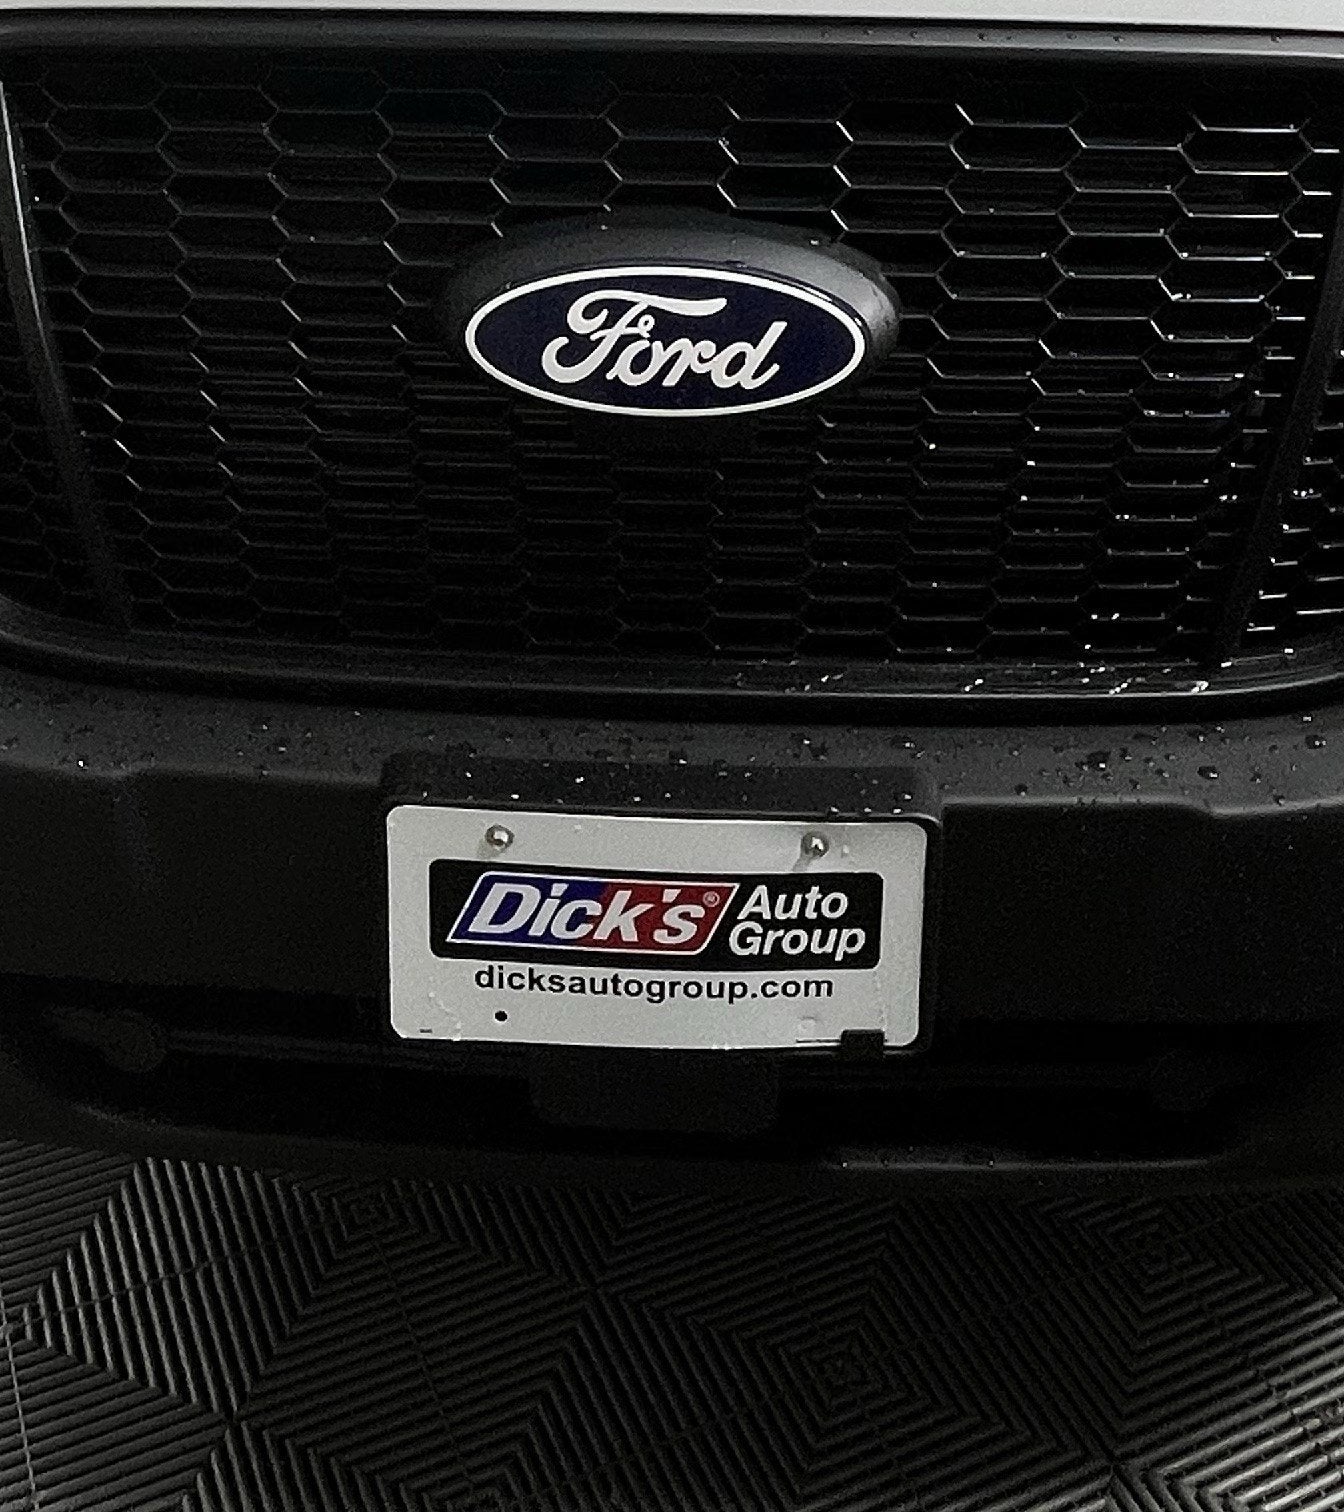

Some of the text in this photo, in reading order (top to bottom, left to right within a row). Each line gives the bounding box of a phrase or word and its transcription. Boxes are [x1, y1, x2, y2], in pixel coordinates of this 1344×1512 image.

[542, 289, 788, 389] Ford
[468, 882, 706, 945] Dick's
[737, 886, 849, 921] Auto
[729, 920, 866, 961] Group
[474, 965, 834, 1003] dicksautogroup.com
